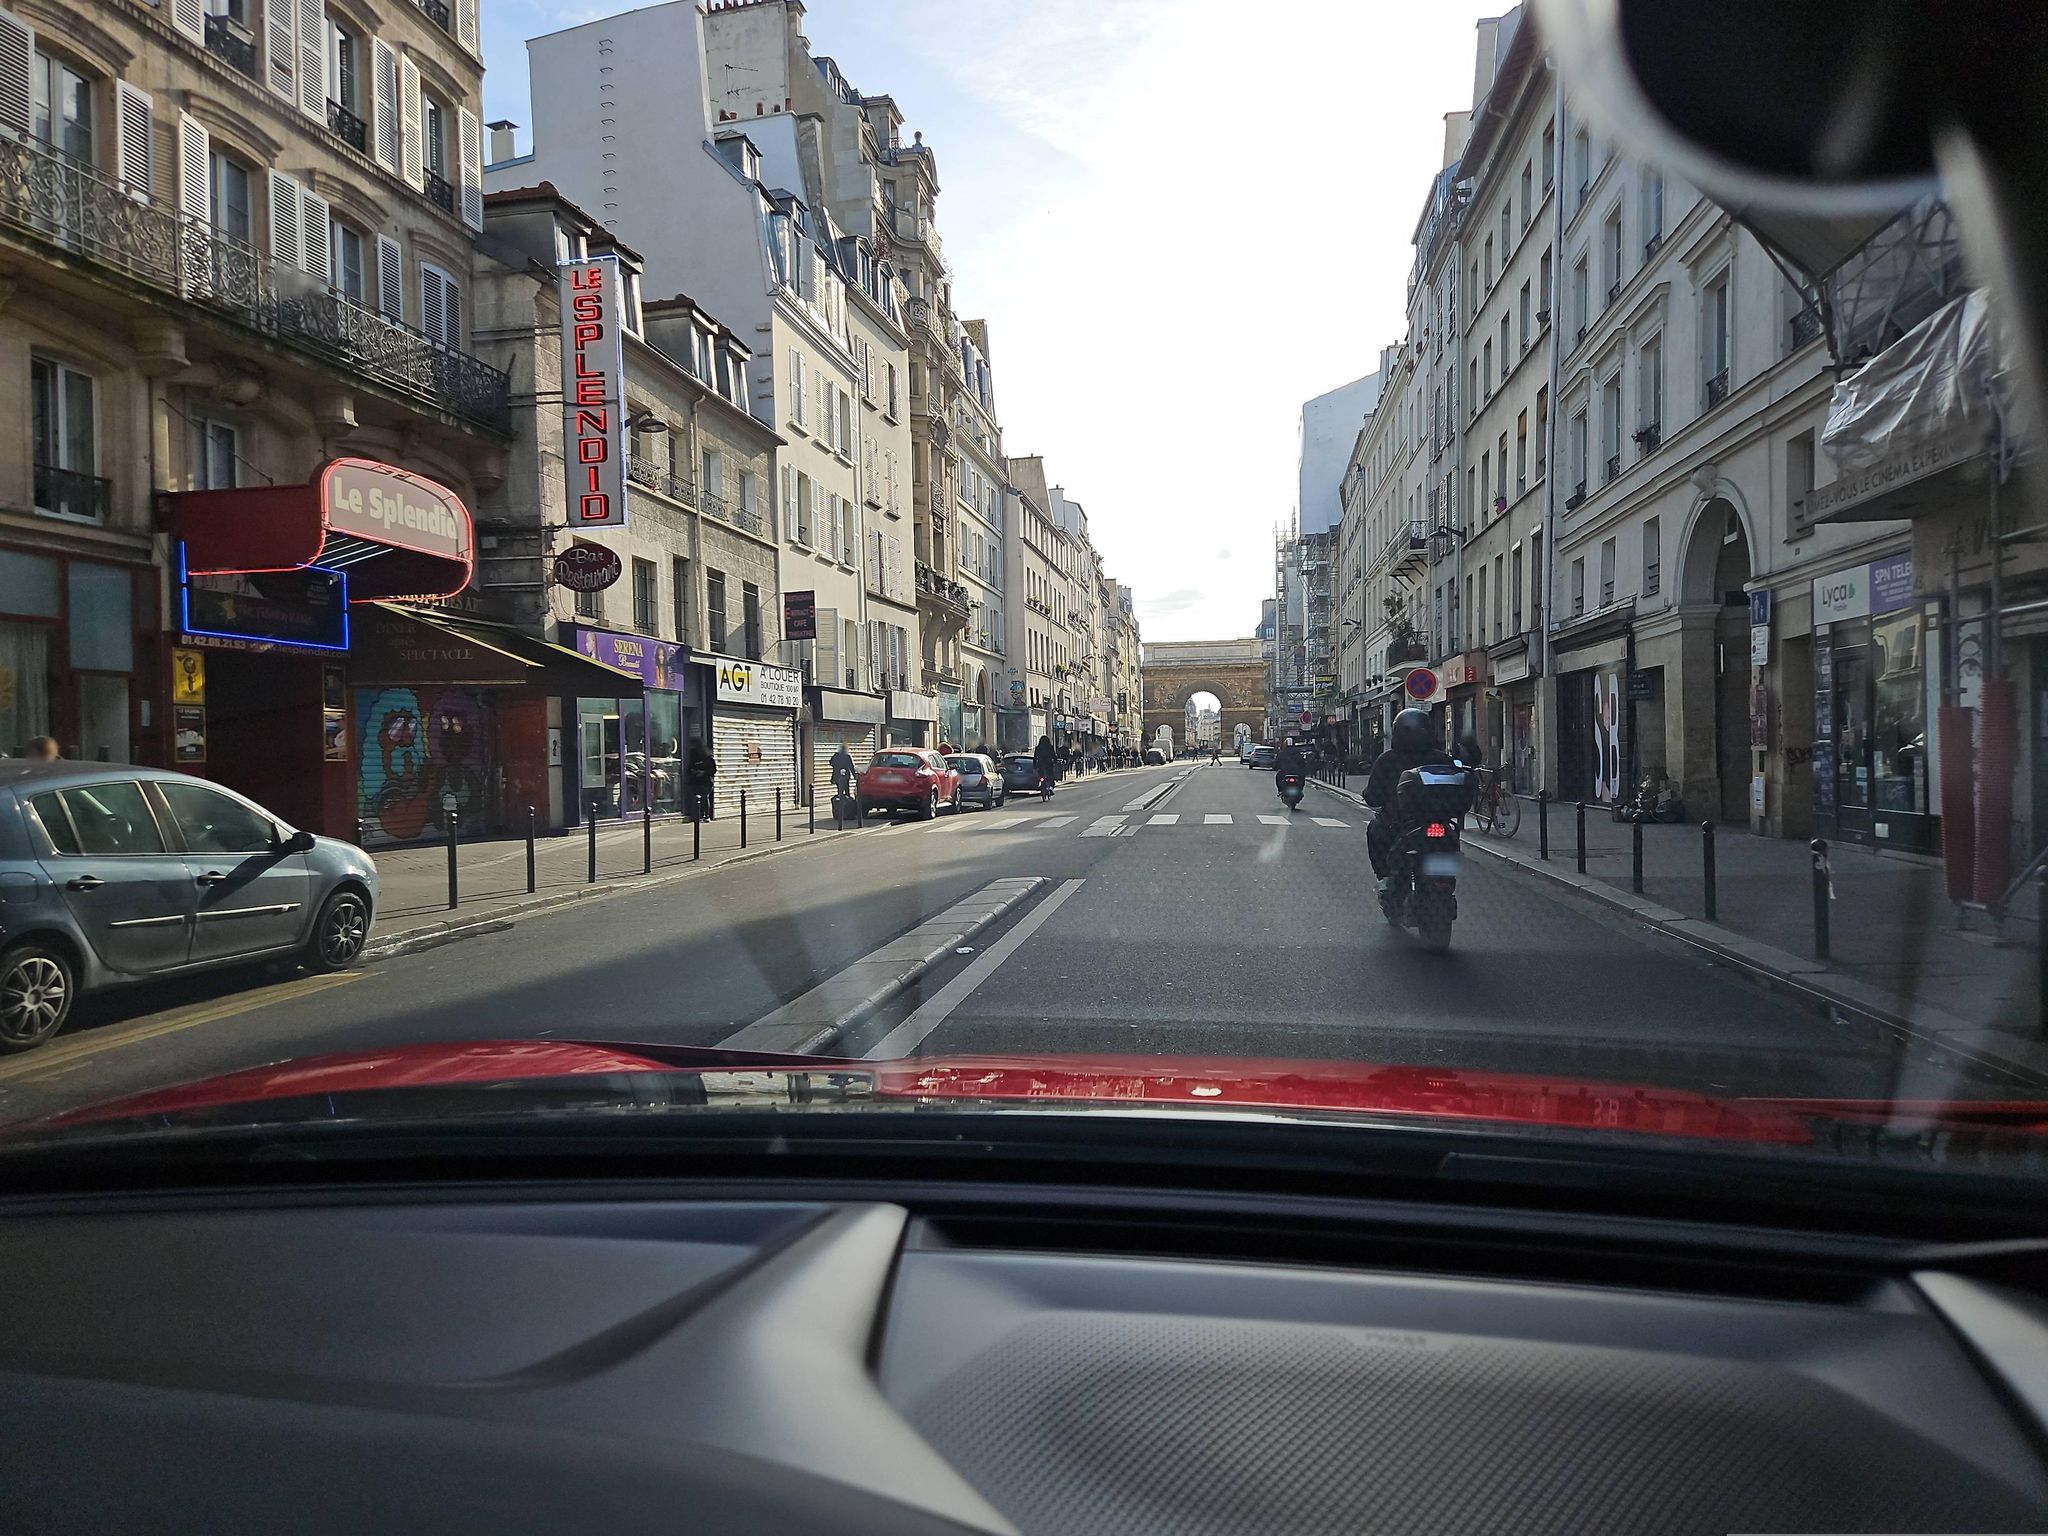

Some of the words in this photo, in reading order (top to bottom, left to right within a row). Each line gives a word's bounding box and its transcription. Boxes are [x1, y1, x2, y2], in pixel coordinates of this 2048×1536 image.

[572, 269, 602, 290] LE
[573, 295, 609, 521] SPLENDID
[334, 476, 362, 514] Le
[369, 487, 459, 540] Splendid
[568, 548, 604, 564] Bar
[555, 560, 619, 590] Restaurant
[1874, 567, 1891, 584] SPN
[1822, 584, 1847, 608] Lyca
[400, 648, 474, 660] SPECTACLE
[614, 638, 643, 657] SERENA
[720, 663, 751, 692] AGT
[769, 668, 799, 683] LOUER
[760, 680, 785, 692] BOUTIQUE
[761, 693, 767, 703] 01
[769, 695, 776, 704] 42
